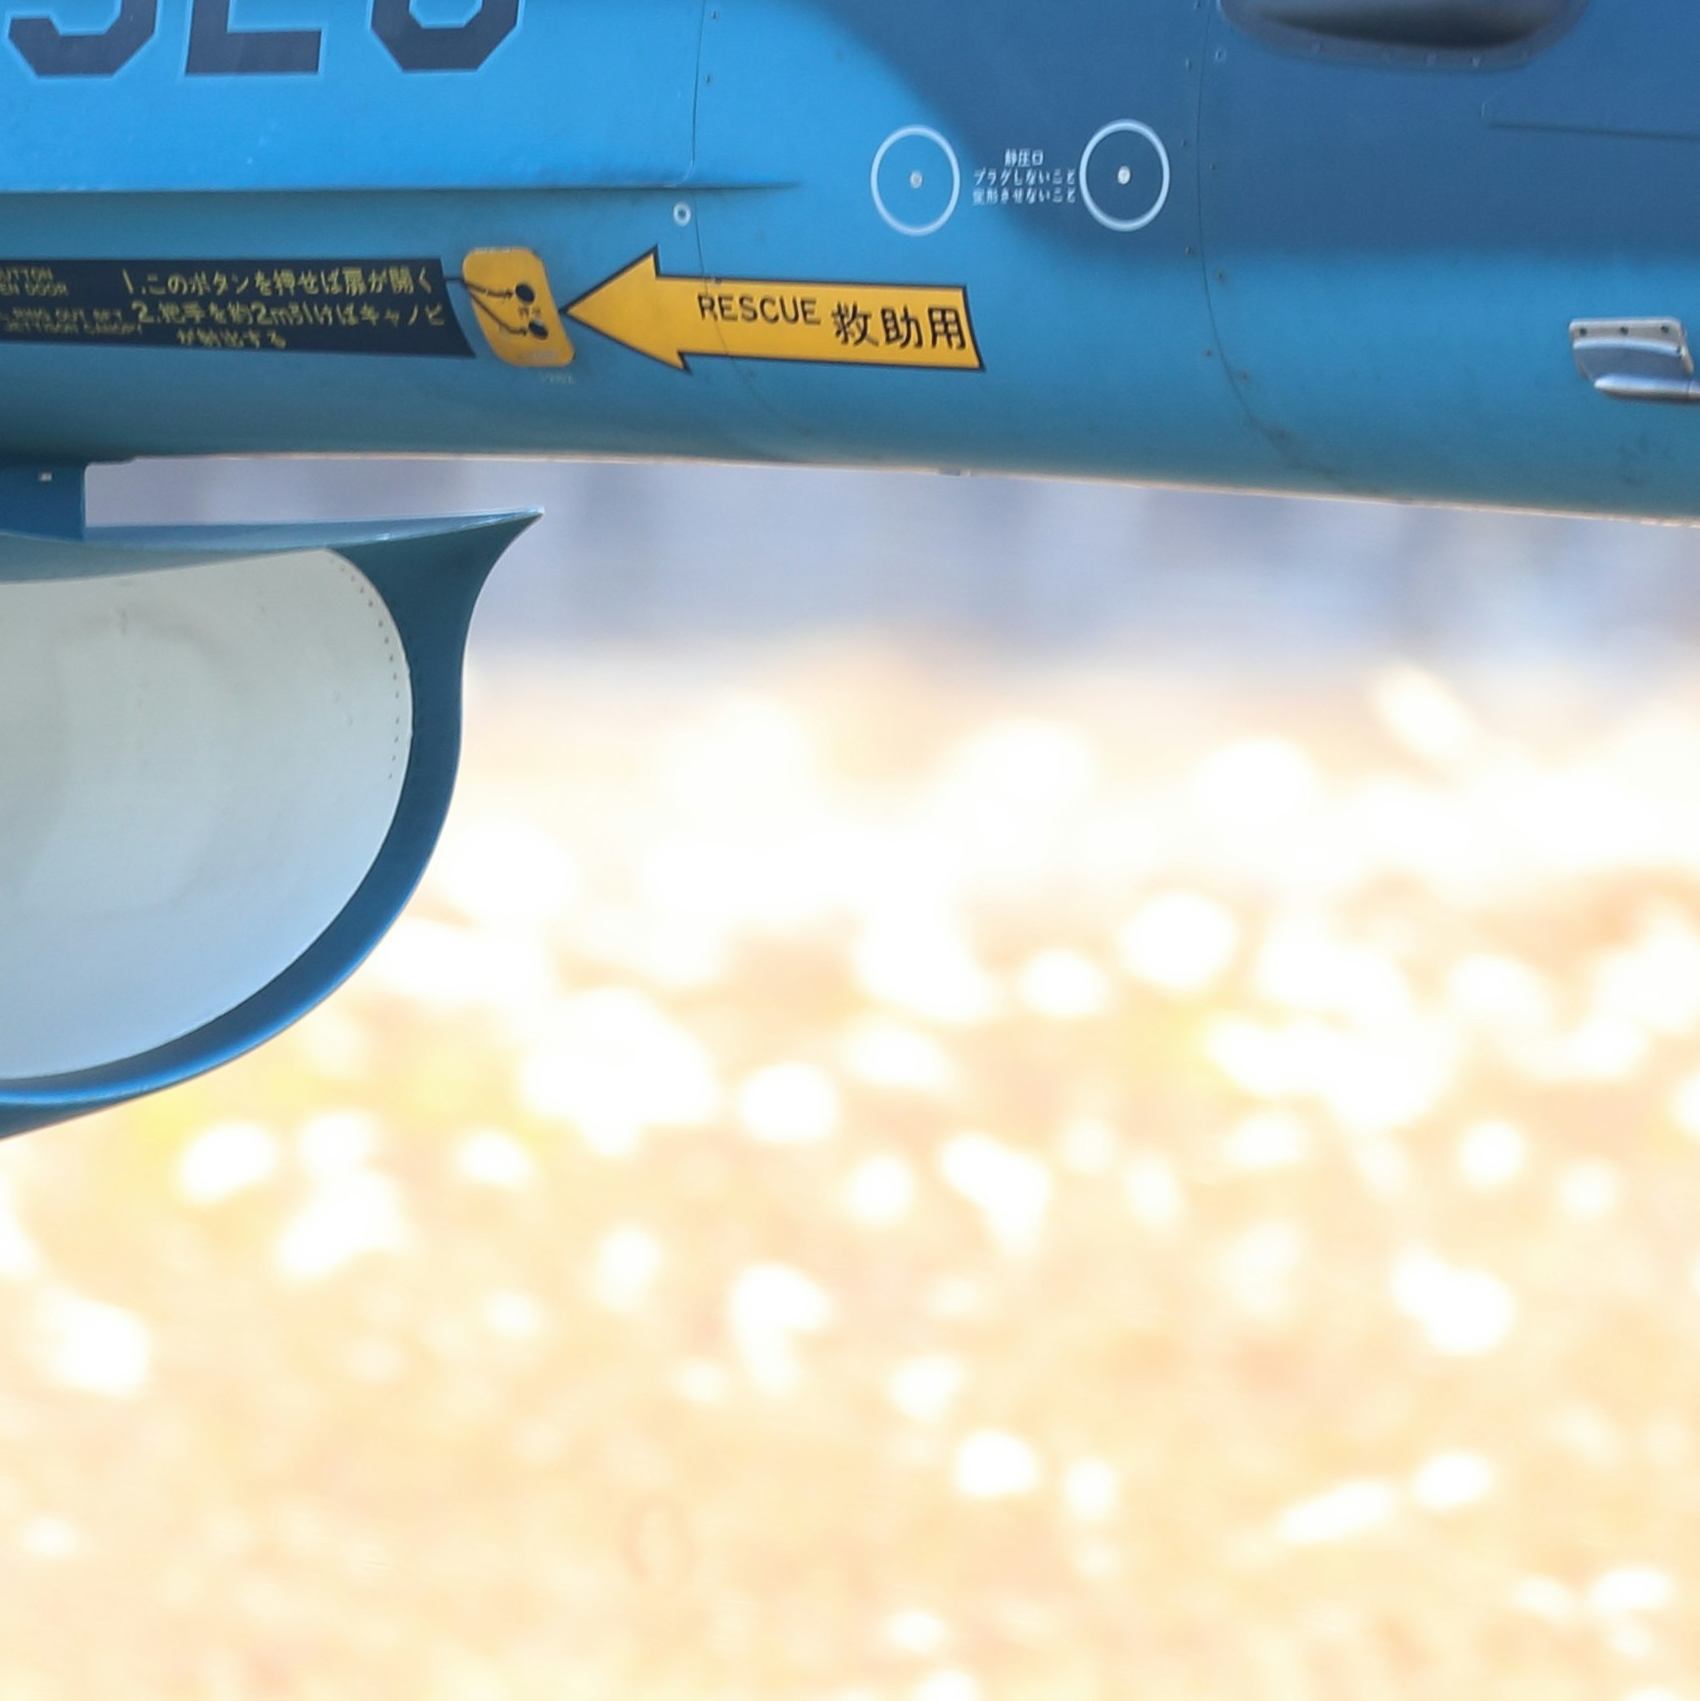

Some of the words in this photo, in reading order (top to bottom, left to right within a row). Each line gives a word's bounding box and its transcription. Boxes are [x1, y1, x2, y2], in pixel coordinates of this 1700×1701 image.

[698, 293, 822, 326] RESCUE
[830, 301, 968, 351] 救助用
